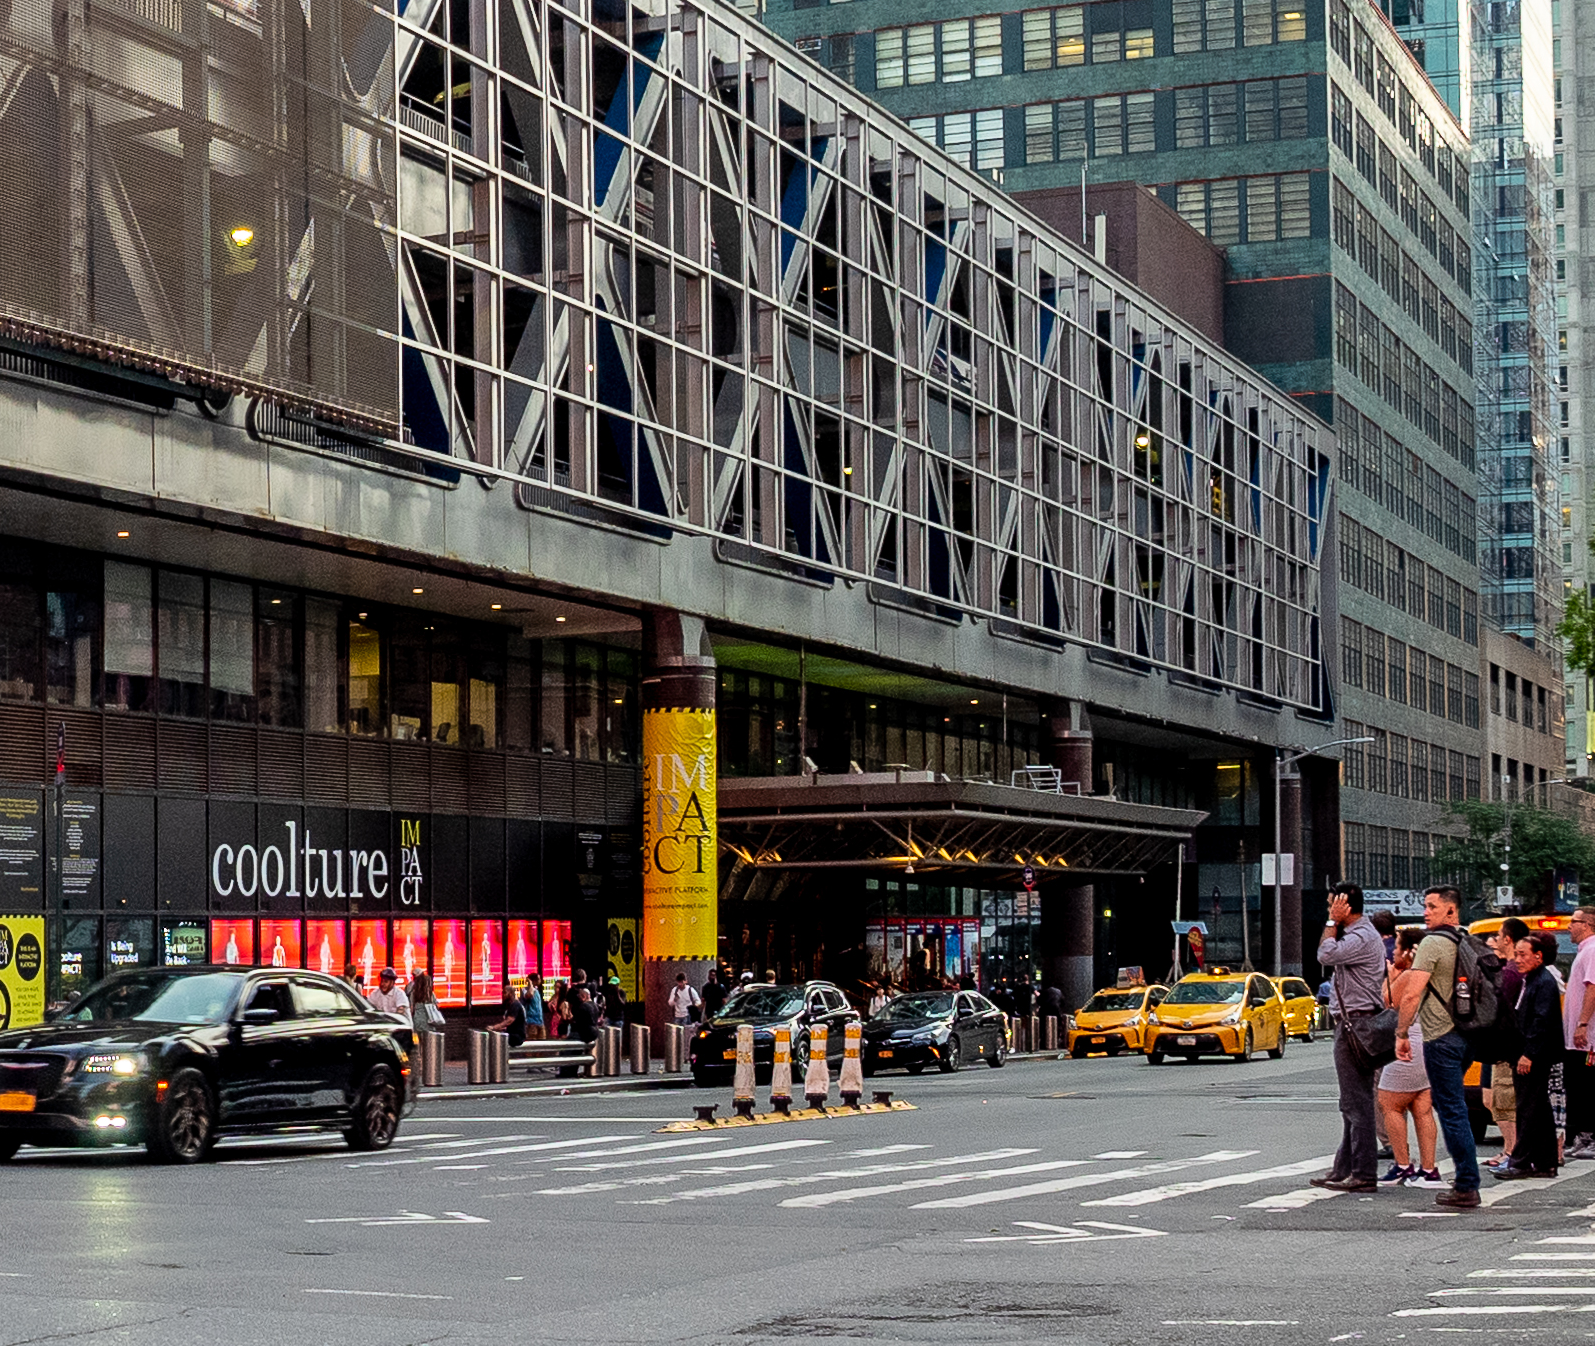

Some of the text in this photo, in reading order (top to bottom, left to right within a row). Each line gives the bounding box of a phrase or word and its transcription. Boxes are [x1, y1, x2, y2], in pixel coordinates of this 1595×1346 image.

[401, 820, 421, 846] IM
[212, 821, 388, 898] coolture
[401, 847, 422, 875] PA
[401, 877, 423, 904] CT
[111, 952, 138, 965] Upgraded
